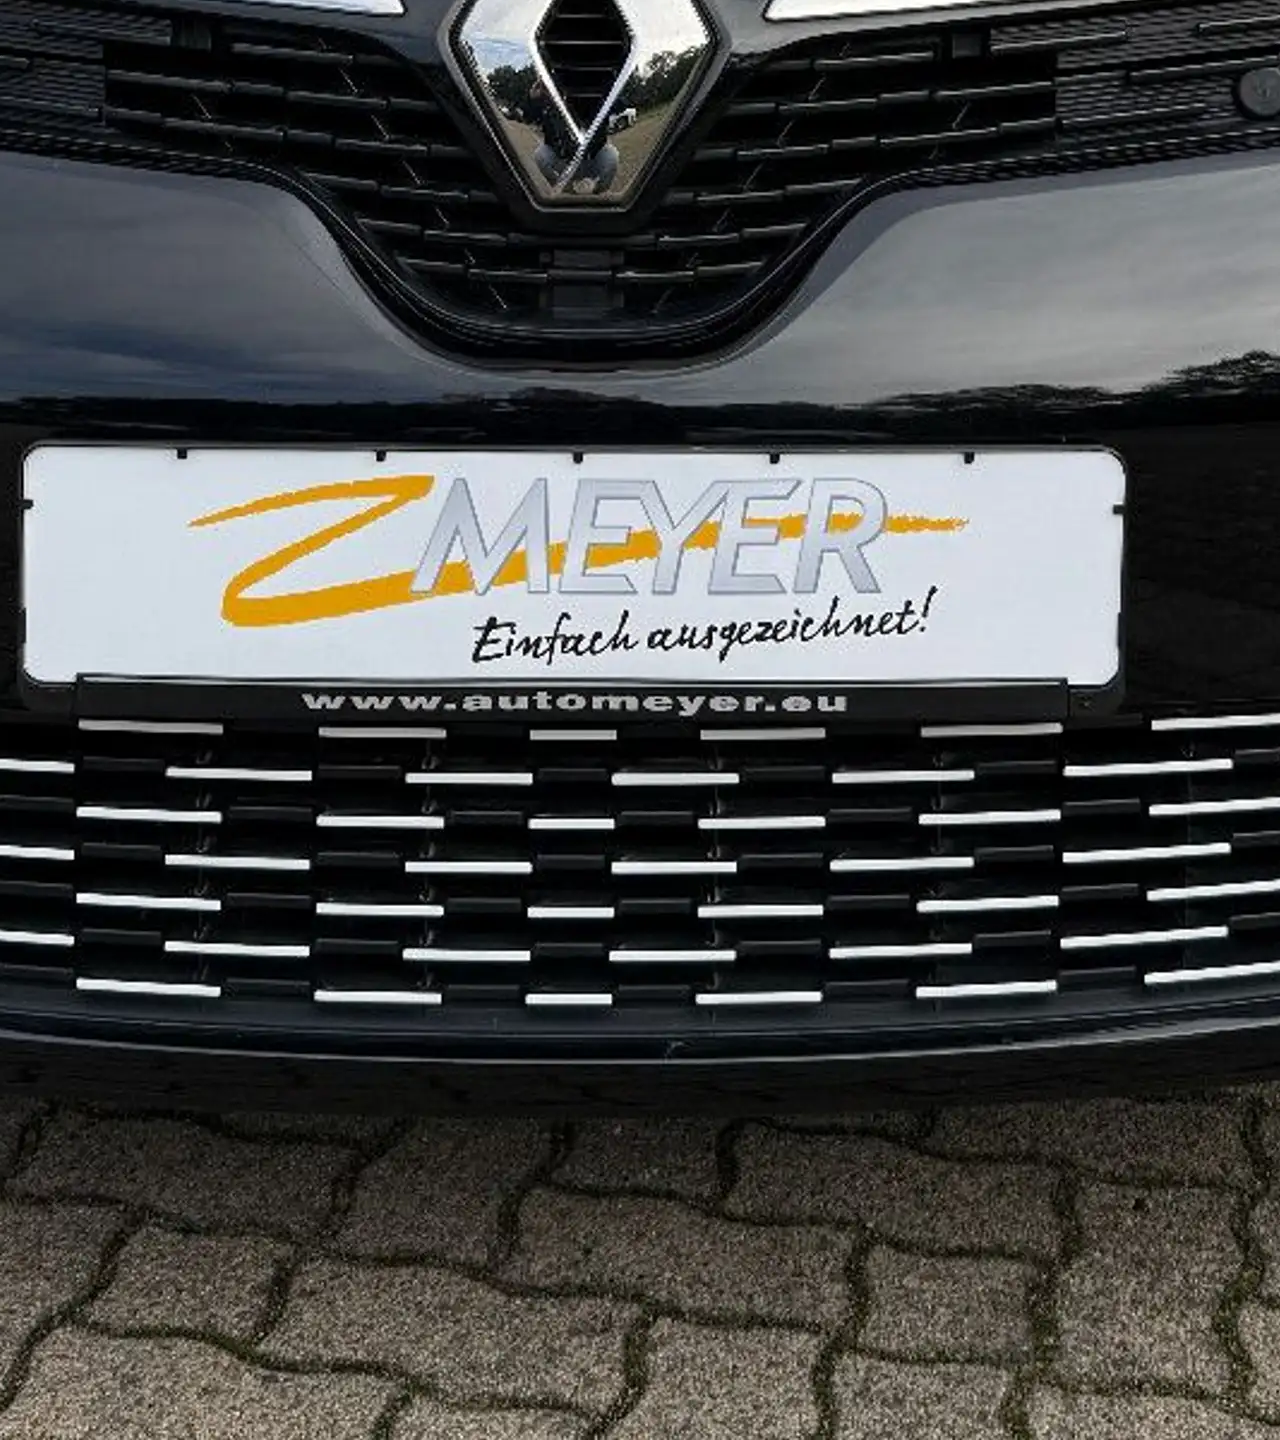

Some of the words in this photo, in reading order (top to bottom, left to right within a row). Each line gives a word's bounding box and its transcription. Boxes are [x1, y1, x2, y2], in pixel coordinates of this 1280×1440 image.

[409, 476, 887, 596] MEYER
[471, 610, 639, 664] Einfach
[647, 585, 938, 662] ausgezeichnet!
[300, 690, 849, 717] www.automeyer.eu
